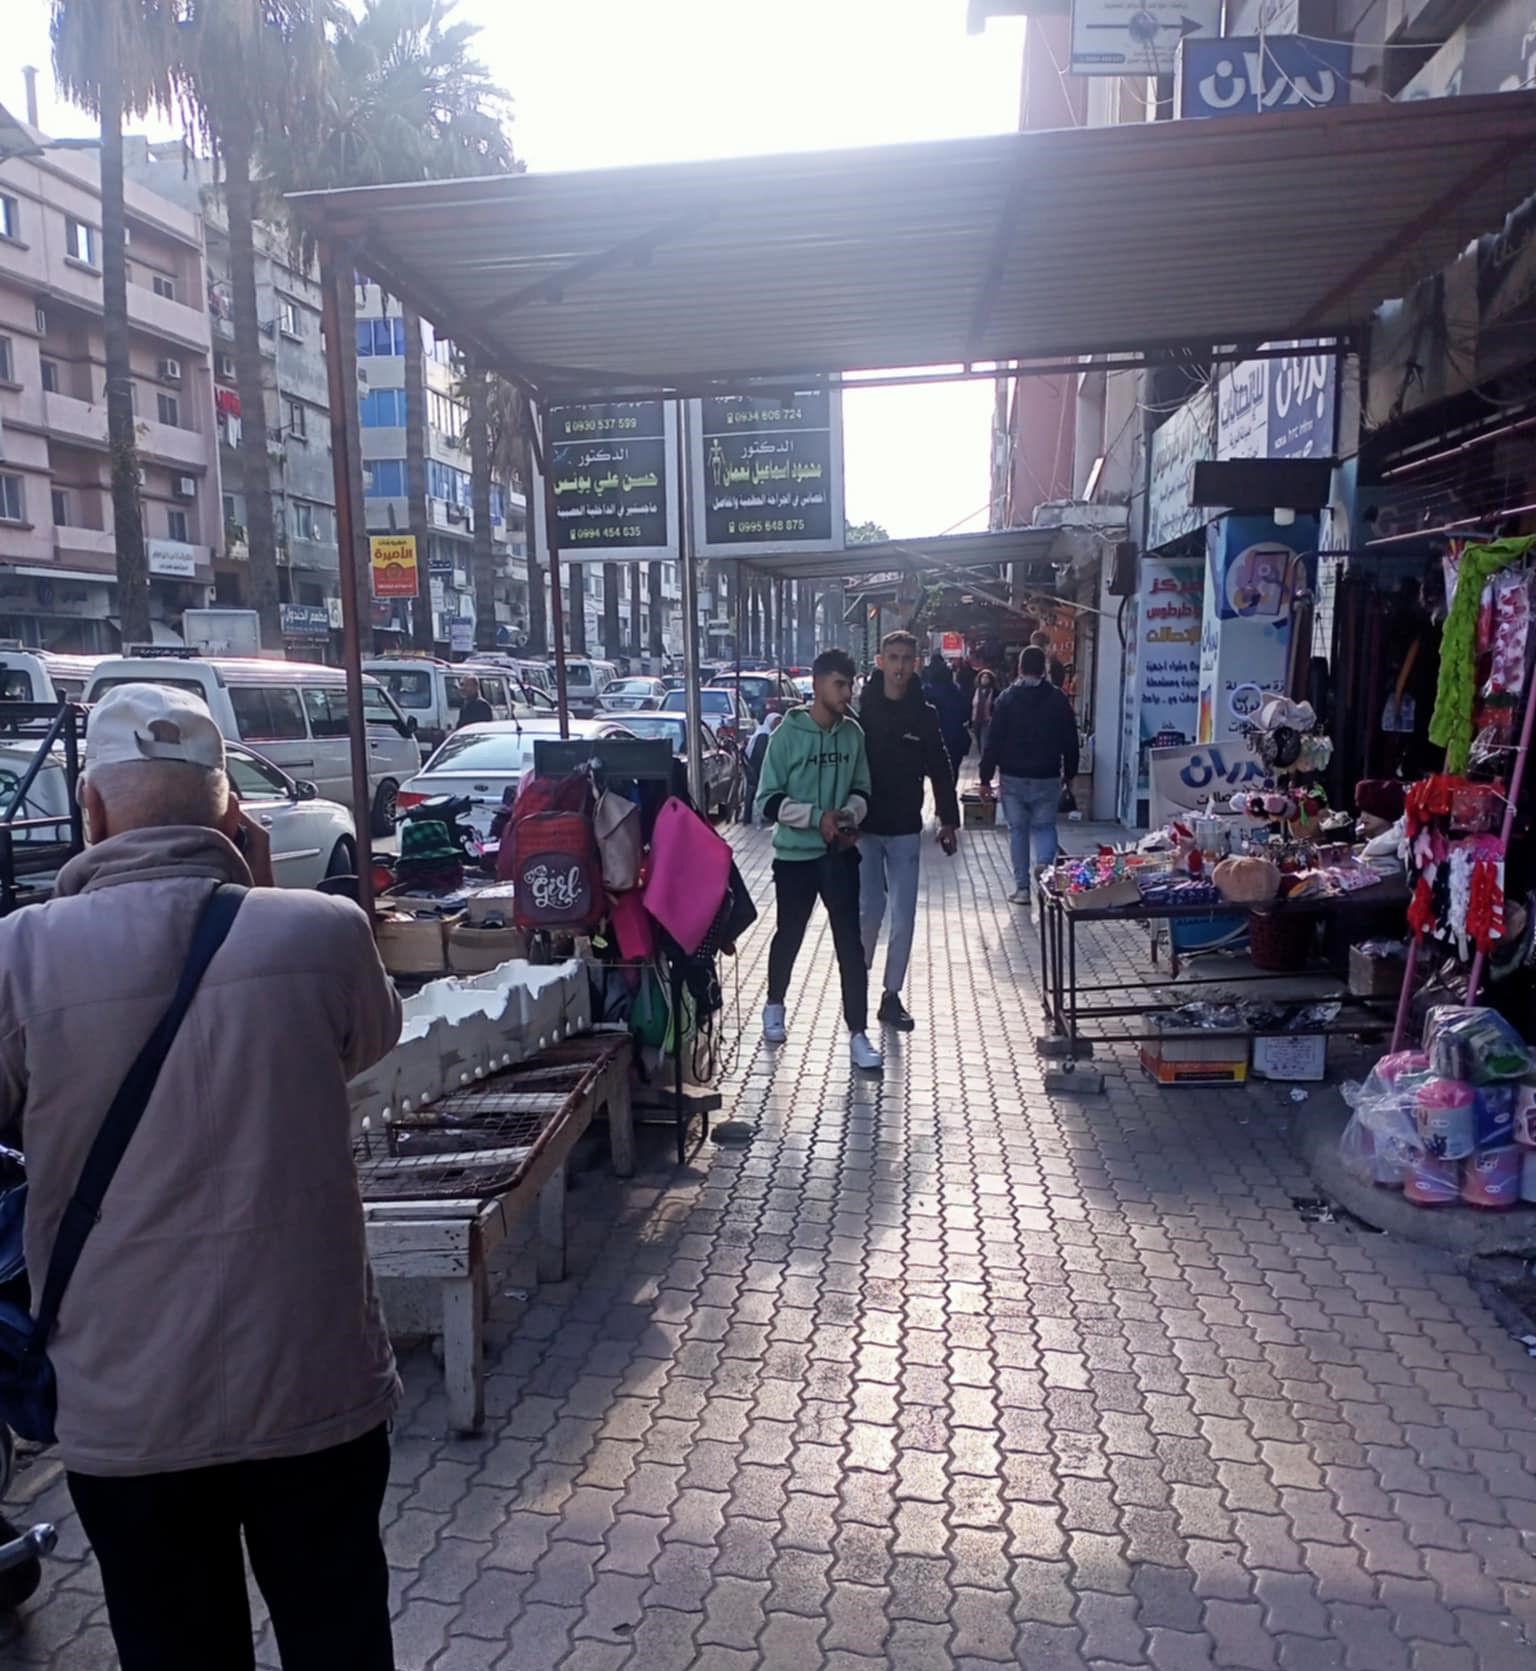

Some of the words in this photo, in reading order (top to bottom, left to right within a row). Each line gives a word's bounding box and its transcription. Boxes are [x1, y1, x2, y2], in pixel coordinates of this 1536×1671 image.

[1199, 51, 1336, 109] بدران
[577, 448, 630, 467] الدكتور
[740, 439, 795, 459] الدكتور
[622, 471, 658, 492] حسن
[791, 462, 823, 483] محمود
[553, 473, 592, 495] يونس
[594, 471, 619, 497] علي
[602, 527, 620, 538] 454
[374, 546, 413, 561] الأميرة
[1149, 577, 1204, 595] مركز
[532, 865, 580, 910] Girl
